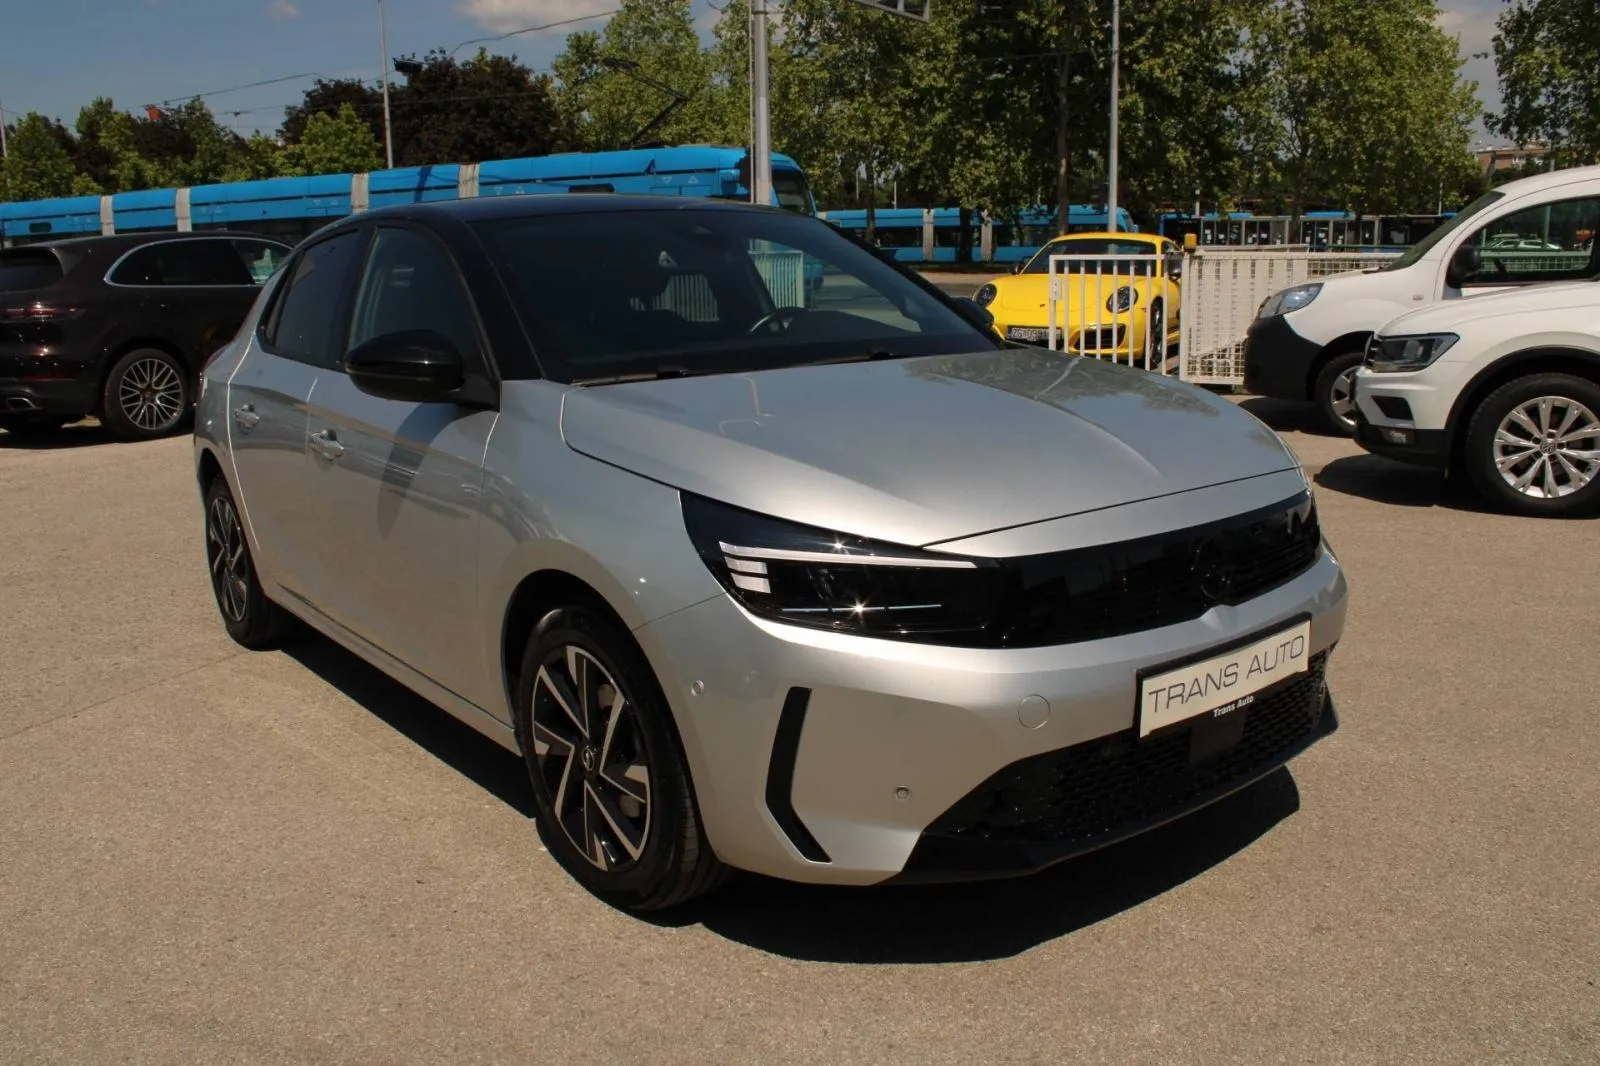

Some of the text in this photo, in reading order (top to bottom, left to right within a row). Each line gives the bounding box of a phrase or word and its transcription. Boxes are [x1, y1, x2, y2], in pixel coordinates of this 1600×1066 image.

[1148, 635, 1304, 713] TRANS AUTO
[1212, 695, 1254, 718] Trans Auto
